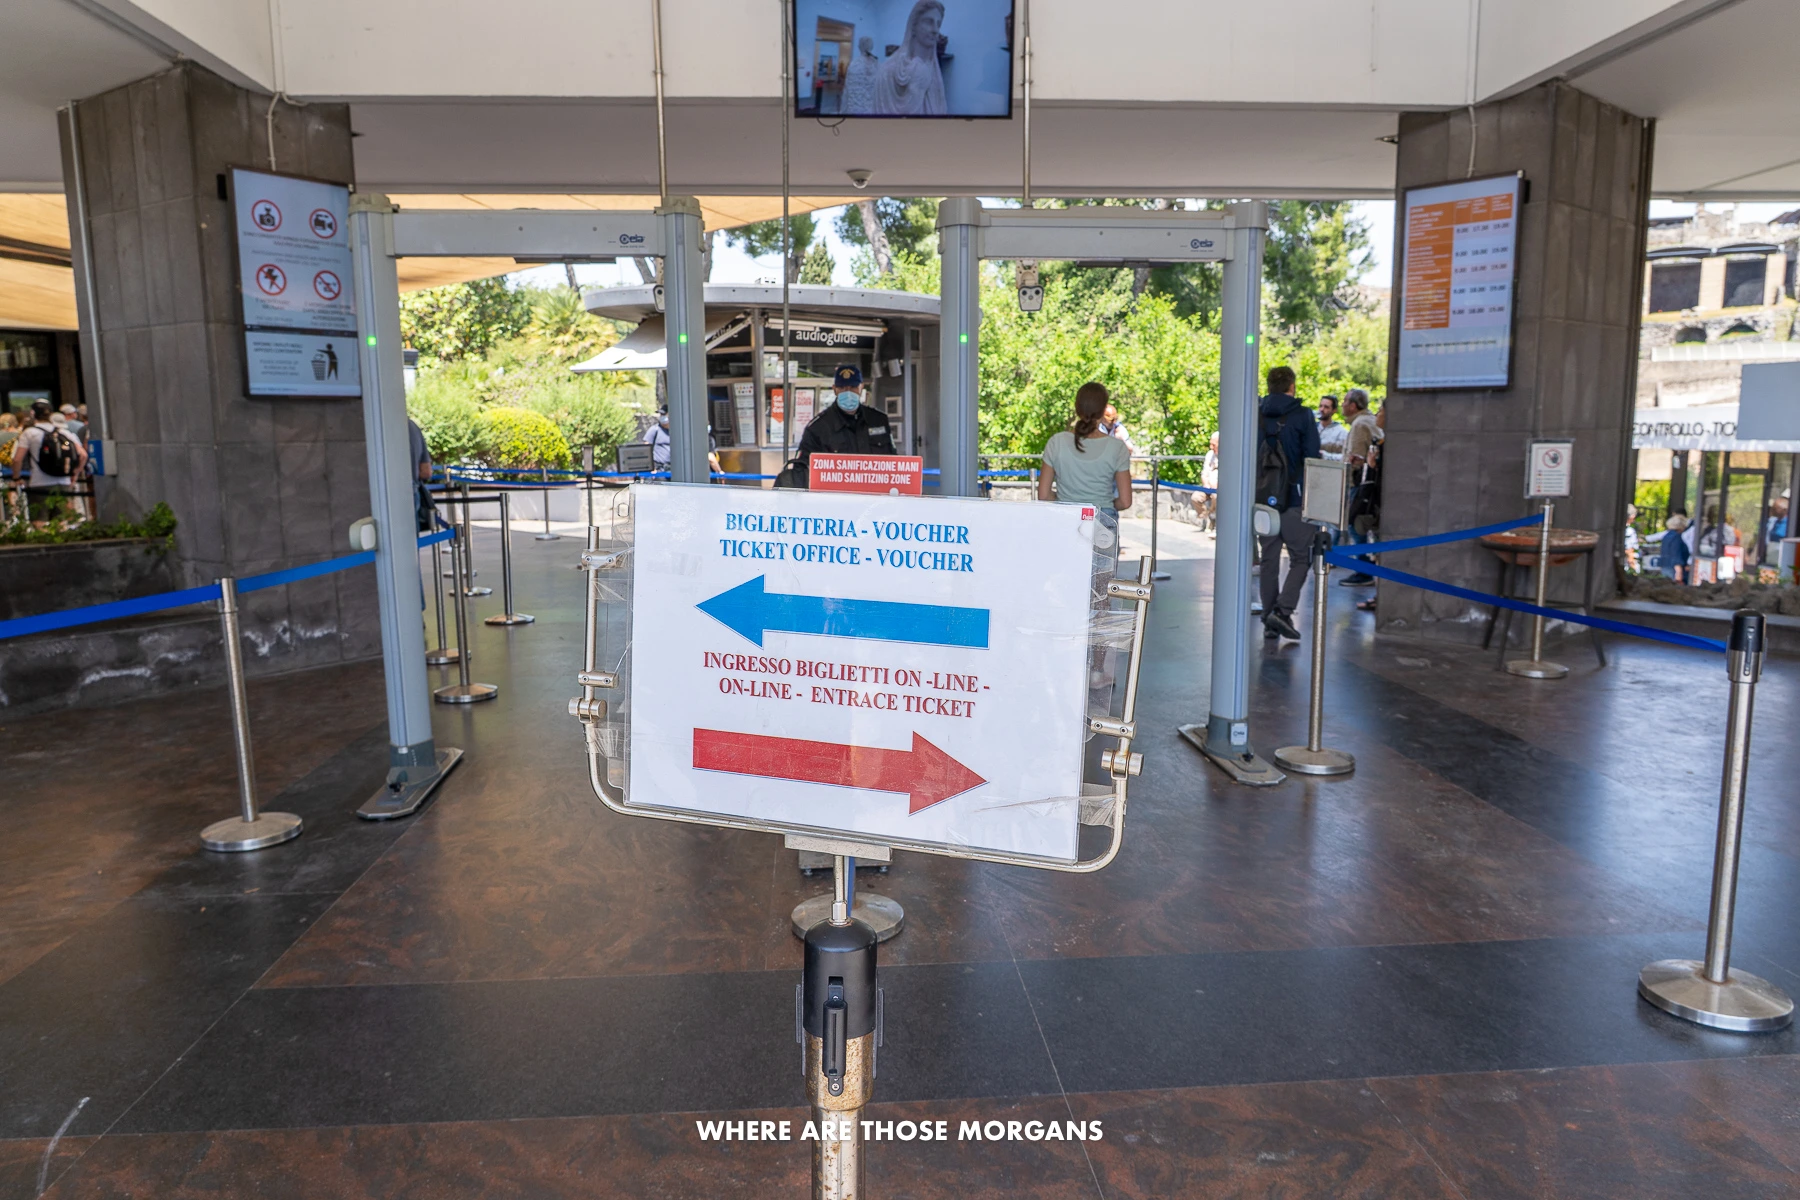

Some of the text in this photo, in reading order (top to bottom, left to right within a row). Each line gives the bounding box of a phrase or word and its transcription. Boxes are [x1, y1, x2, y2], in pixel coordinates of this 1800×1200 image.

[795, 328, 858, 346] audioguide
[1633, 422, 1704, 436] CONTROLLO
[813, 458, 920, 473] ZONA SANIFICAZIONE MANI
[820, 471, 911, 485] HAND SANITIZING ZONE
[725, 512, 858, 538] BIGLIETTERIA
[873, 521, 970, 544] VOUCHER
[719, 539, 788, 560] TICKET
[792, 543, 861, 565] OFFICE
[876, 548, 974, 572] VOUCHER
[703, 651, 791, 675] INGRESSO
[796, 659, 890, 685] BIGLIETTI
[894, 668, 922, 687] ON
[719, 677, 792, 700] ON-LINE
[811, 686, 898, 711] ENTRACE
[903, 694, 976, 718] TICKET
